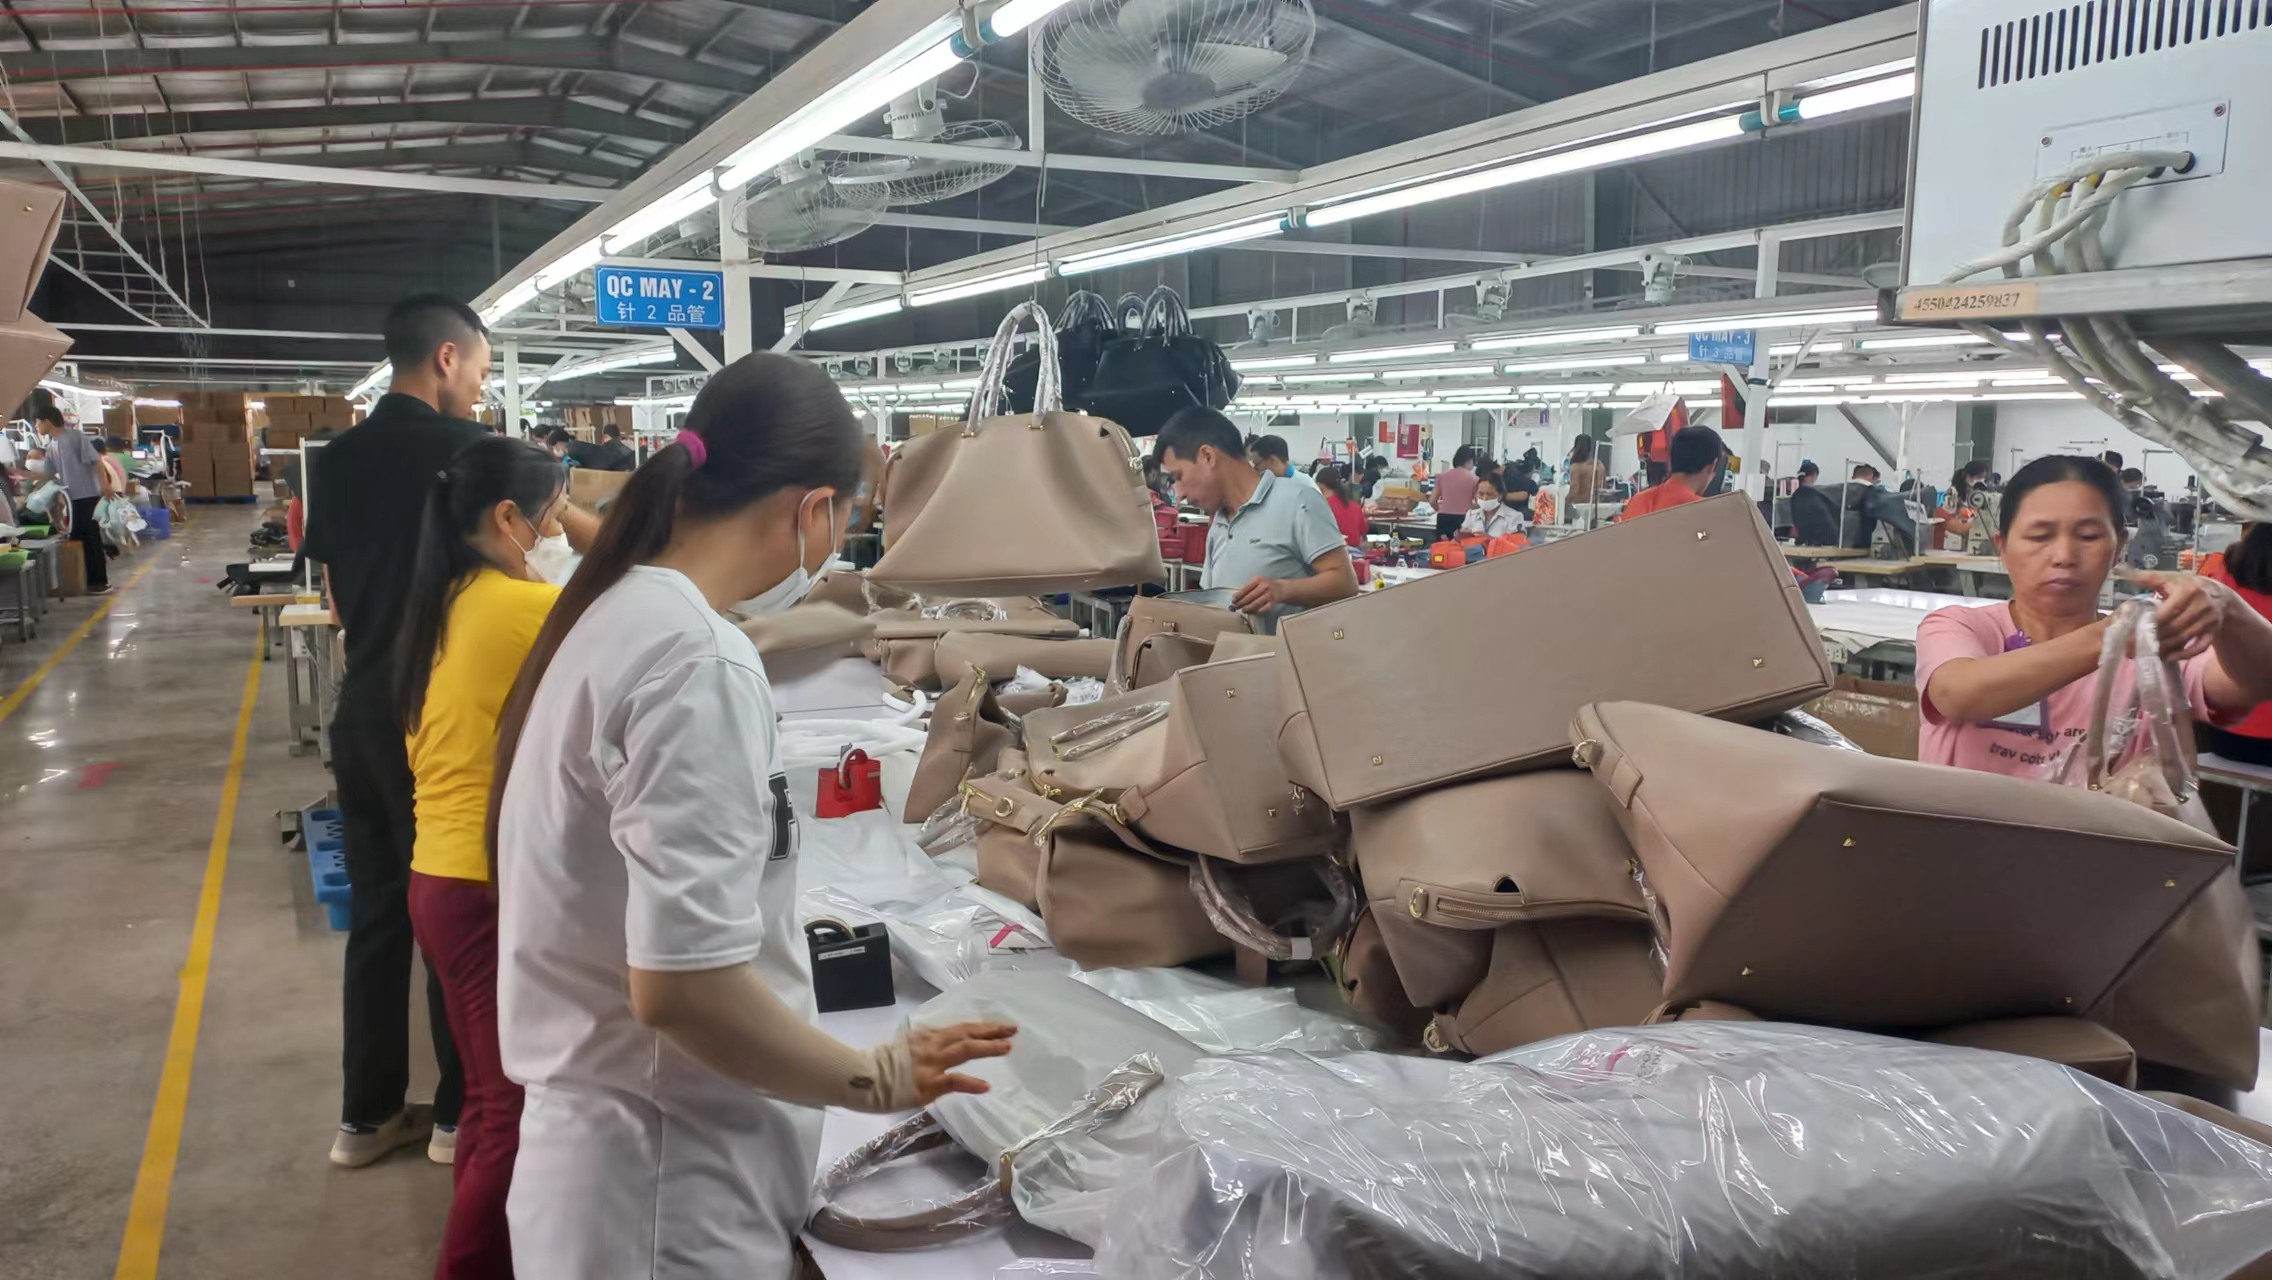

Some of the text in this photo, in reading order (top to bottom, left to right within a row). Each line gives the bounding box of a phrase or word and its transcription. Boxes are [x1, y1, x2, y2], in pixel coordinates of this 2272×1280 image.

[606, 275, 633, 298] QC
[640, 277, 683, 299] MAY
[702, 280, 715, 301] 2
[617, 301, 706, 323] 针 2 品管
